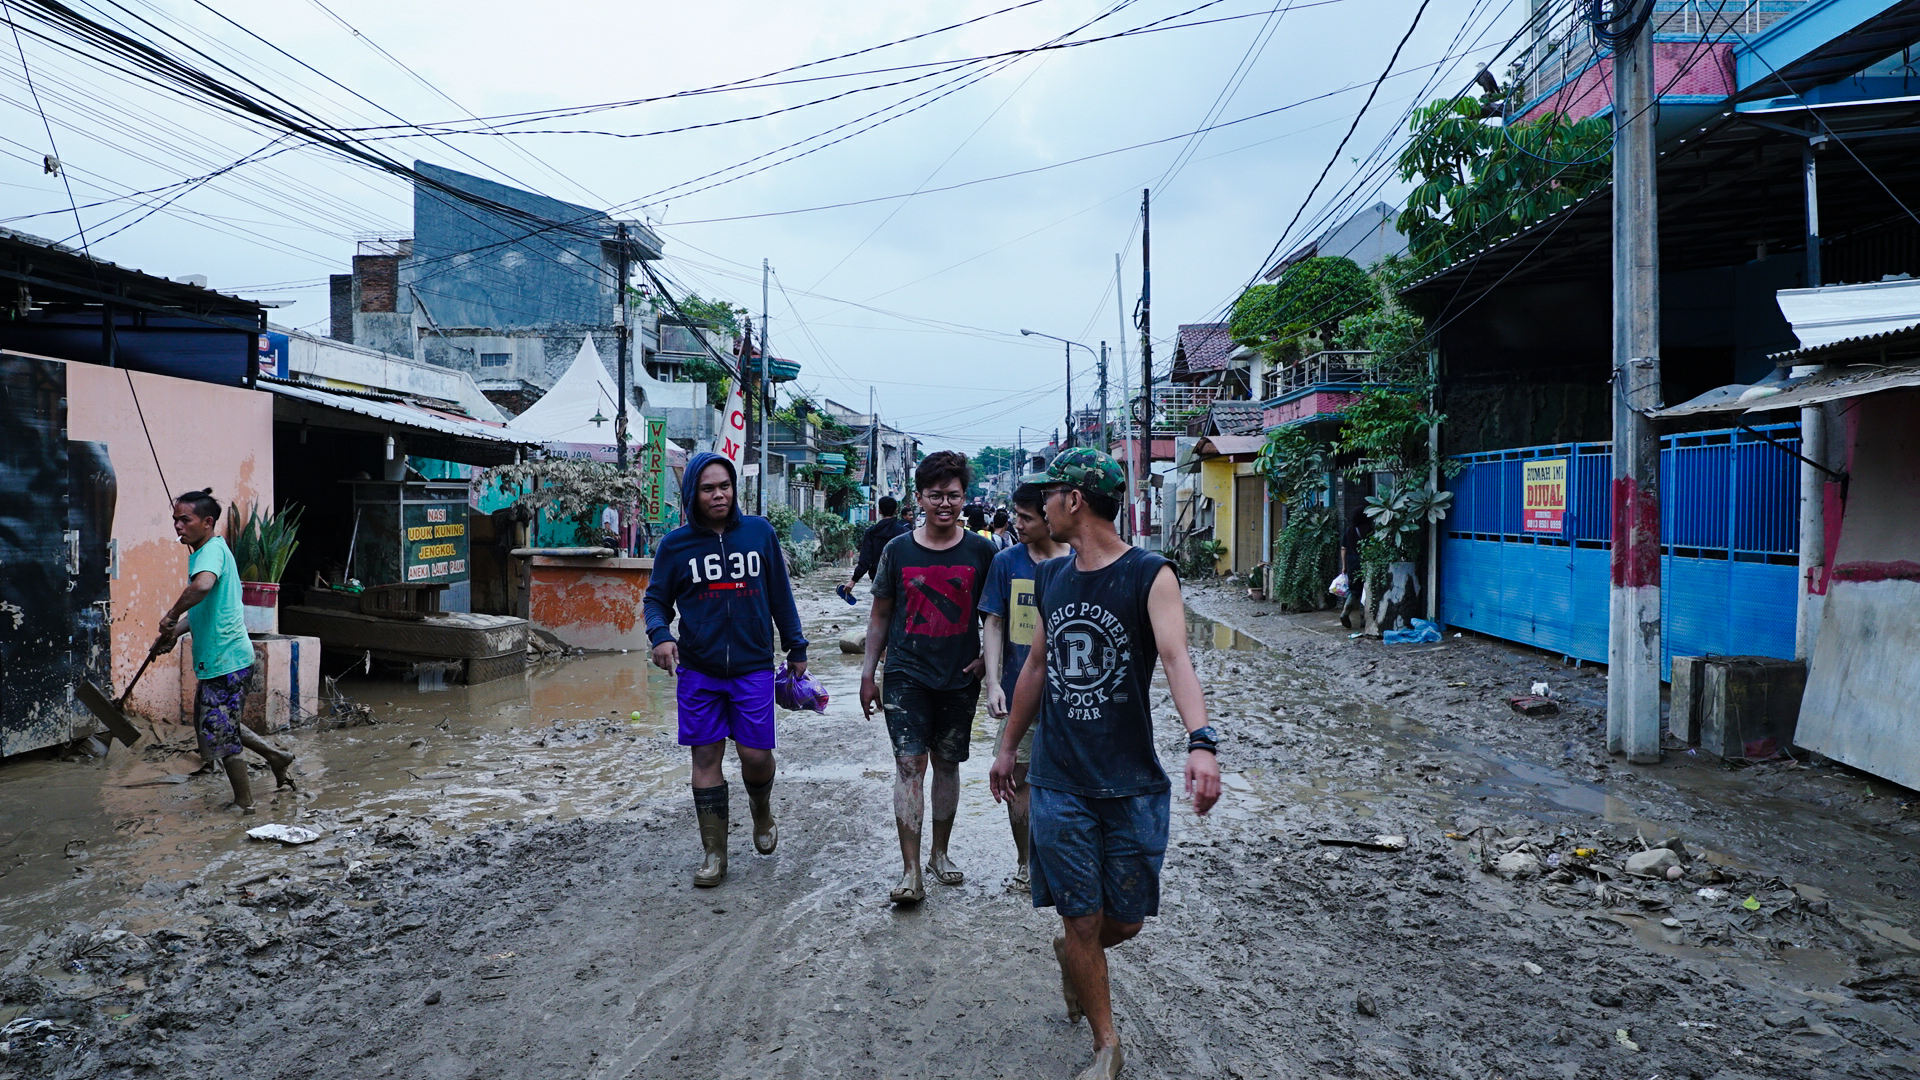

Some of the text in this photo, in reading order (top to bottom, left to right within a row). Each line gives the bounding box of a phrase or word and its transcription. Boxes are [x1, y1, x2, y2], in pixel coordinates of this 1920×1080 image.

[571, 451, 592, 459] JAYA
[650, 423, 663, 515] WARTEG
[1527, 466, 1564, 481] RUMAH INI
[1527, 484, 1563, 506] DIJUAL
[428, 509, 446, 522] NASI
[408, 524, 464, 541] UDUK KUNING
[418, 543, 456, 560] JENGKOL
[408, 559, 465, 581] ANEKA LAUK PAUK
[688, 551, 760, 583] 1630
[1046, 602, 1128, 648] MUSIC POWER
[1062, 631, 1101, 678] R
[1063, 687, 1109, 707] ROCK
[1067, 707, 1102, 720] STAR
